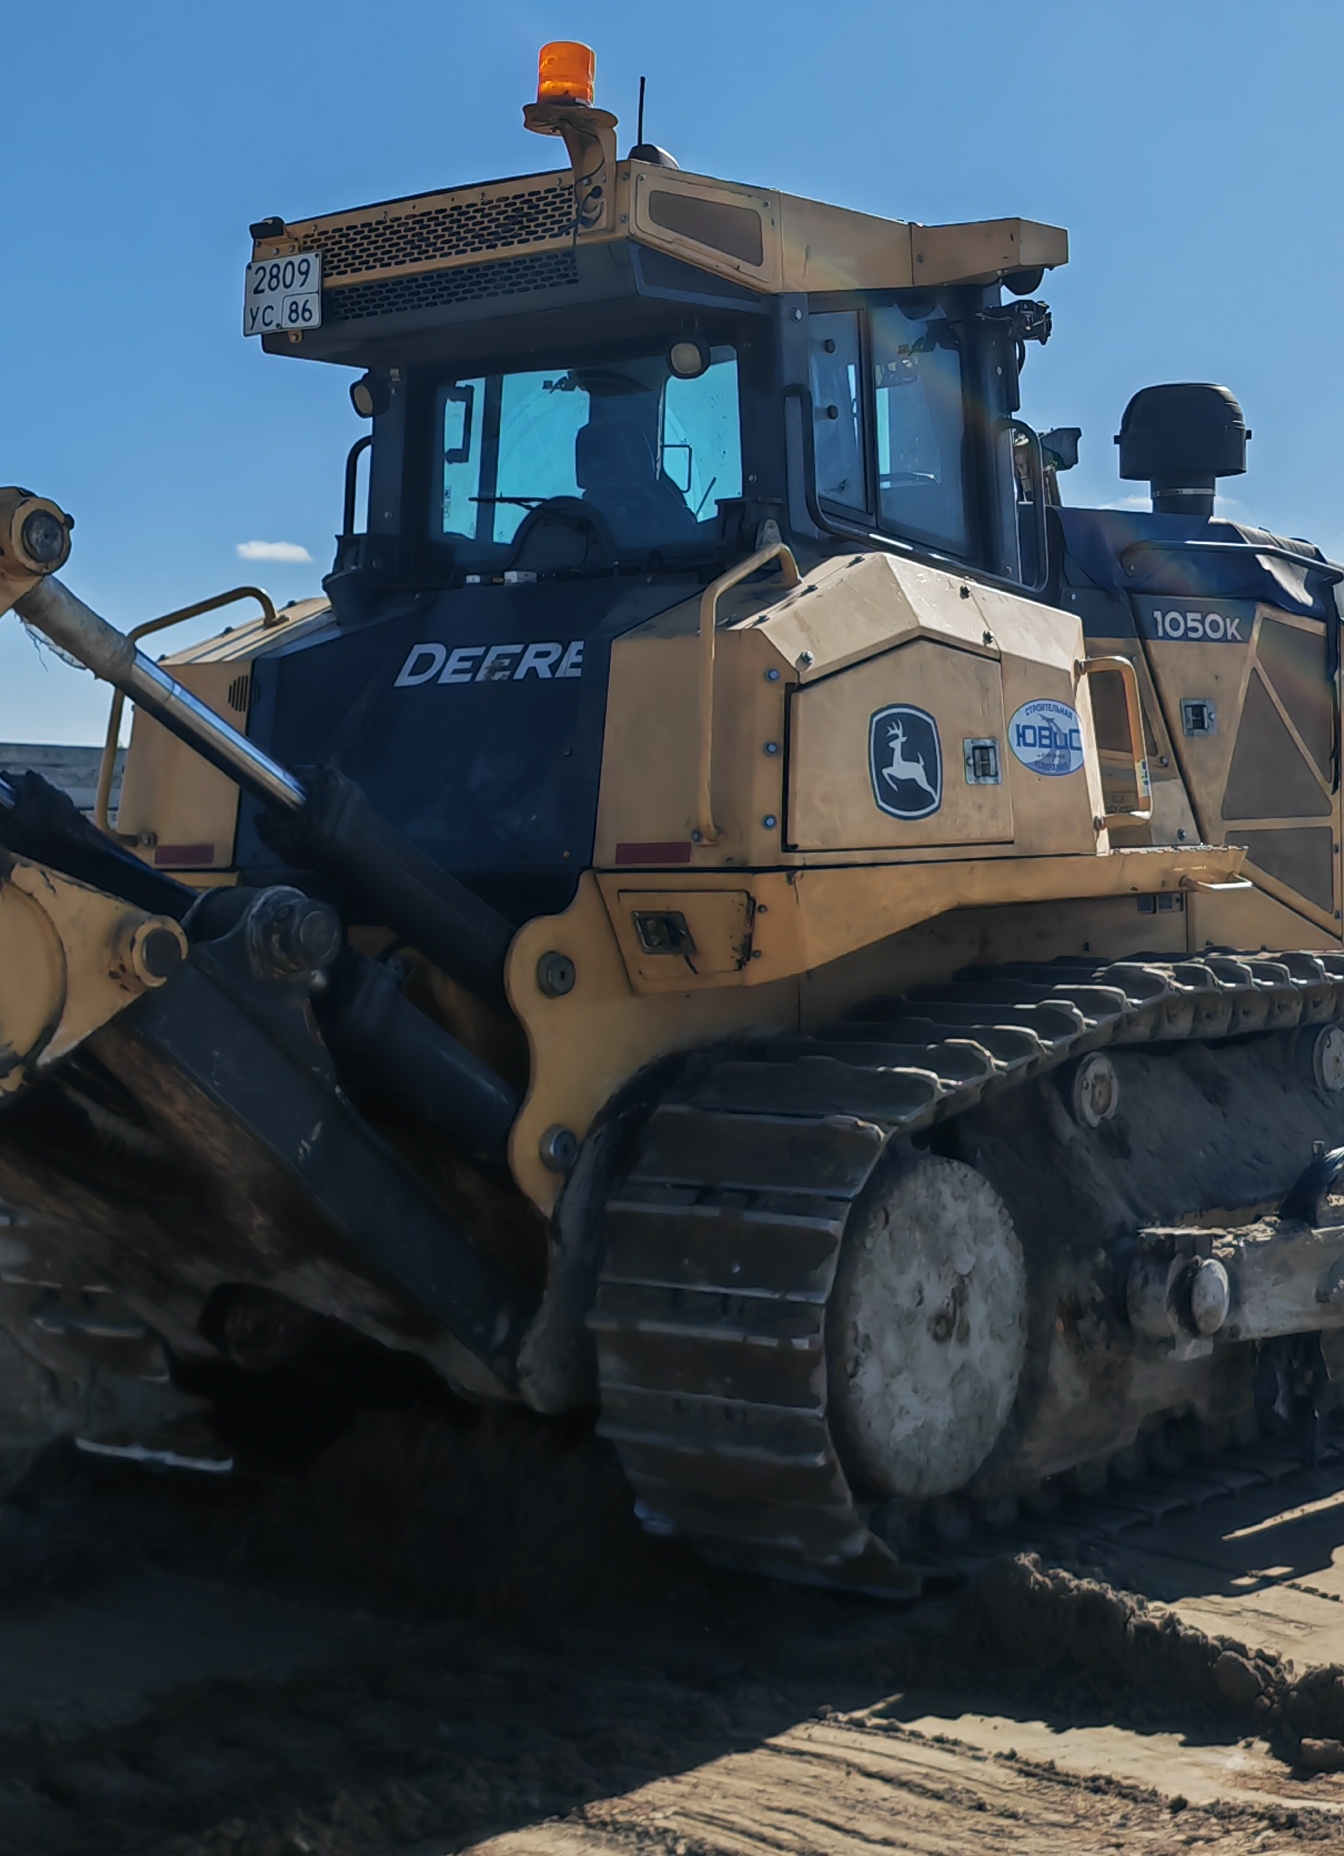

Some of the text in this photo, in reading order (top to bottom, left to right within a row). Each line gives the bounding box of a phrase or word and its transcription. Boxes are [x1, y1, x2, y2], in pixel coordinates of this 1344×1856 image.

[253, 258, 311, 295] 2809
[287, 299, 313, 324] 86
[1153, 610, 1243, 641] 1050K
[393, 640, 585, 688] DEERE
